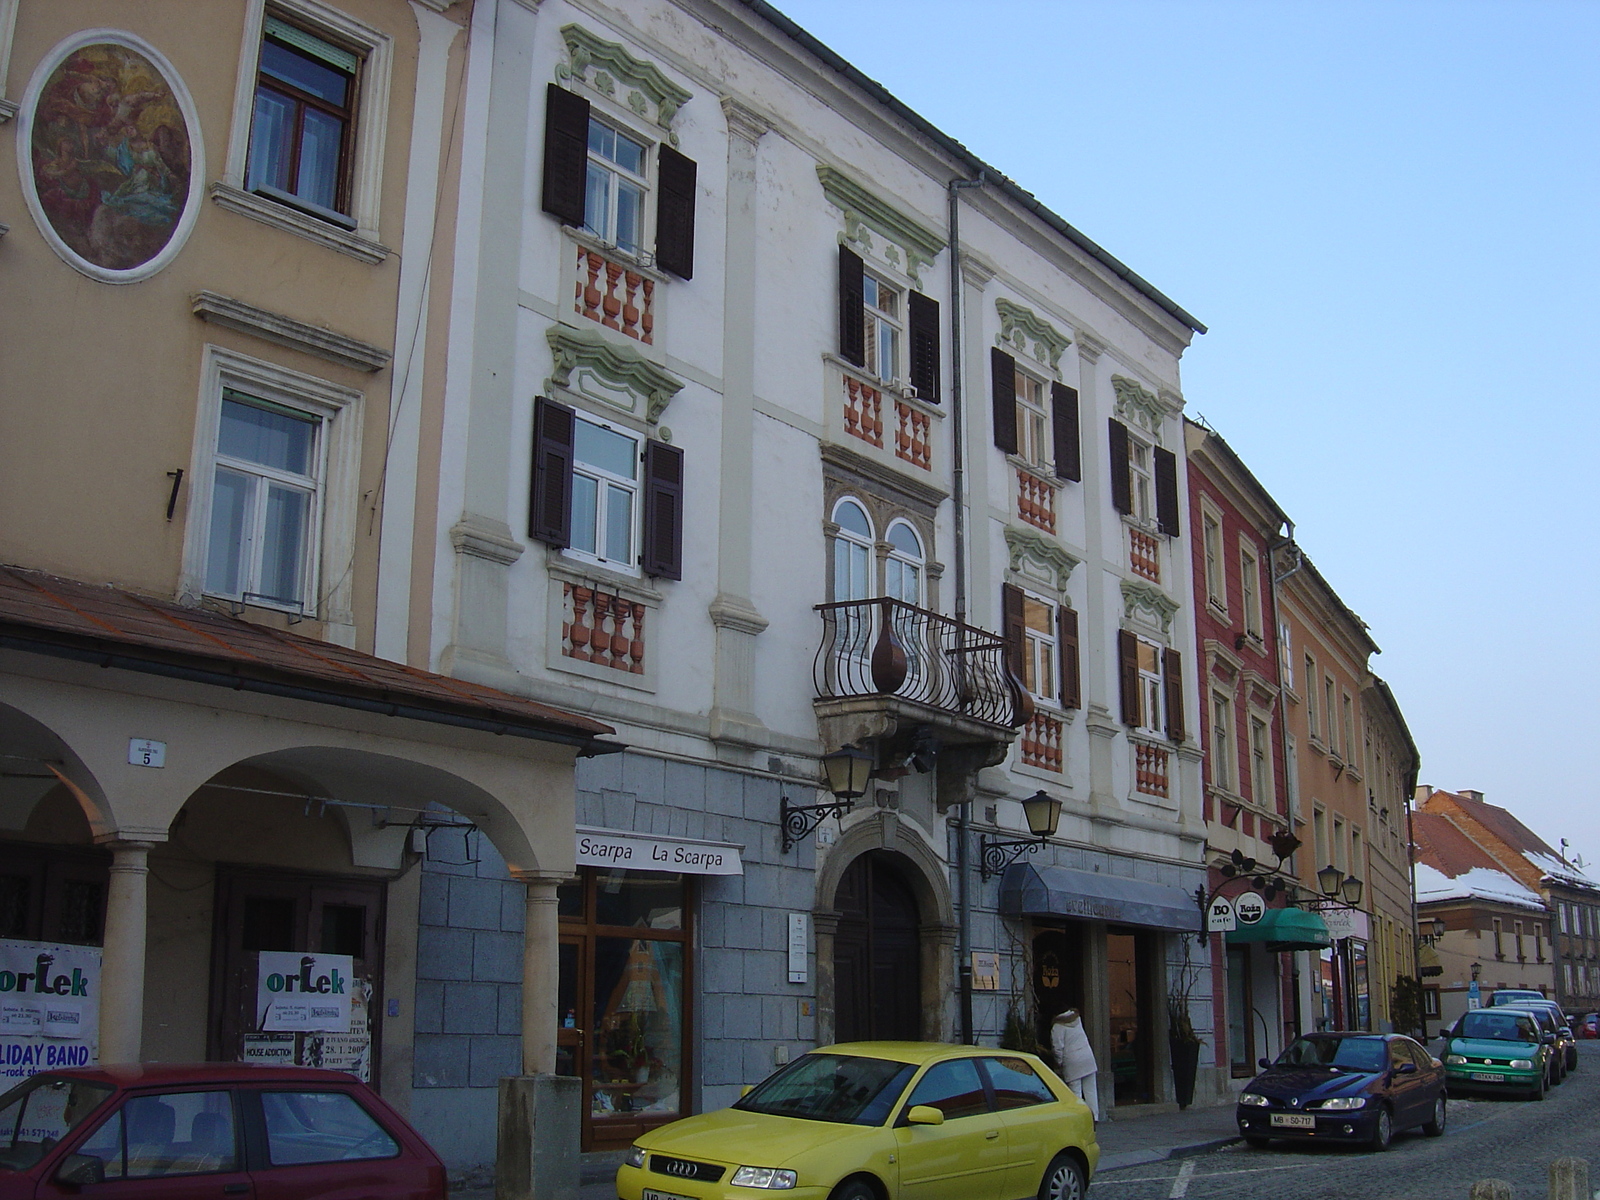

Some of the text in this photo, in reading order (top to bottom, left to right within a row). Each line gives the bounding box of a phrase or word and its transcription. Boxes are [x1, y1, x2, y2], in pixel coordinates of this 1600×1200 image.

[143, 753, 150, 765] 5
[579, 838, 723, 870] Scarpa La Scarpa
[246, 1048, 292, 1057] HOUSE ADDICTION
[325, 1045, 337, 1054] 28.
[46, 1045, 89, 1067] BAND
